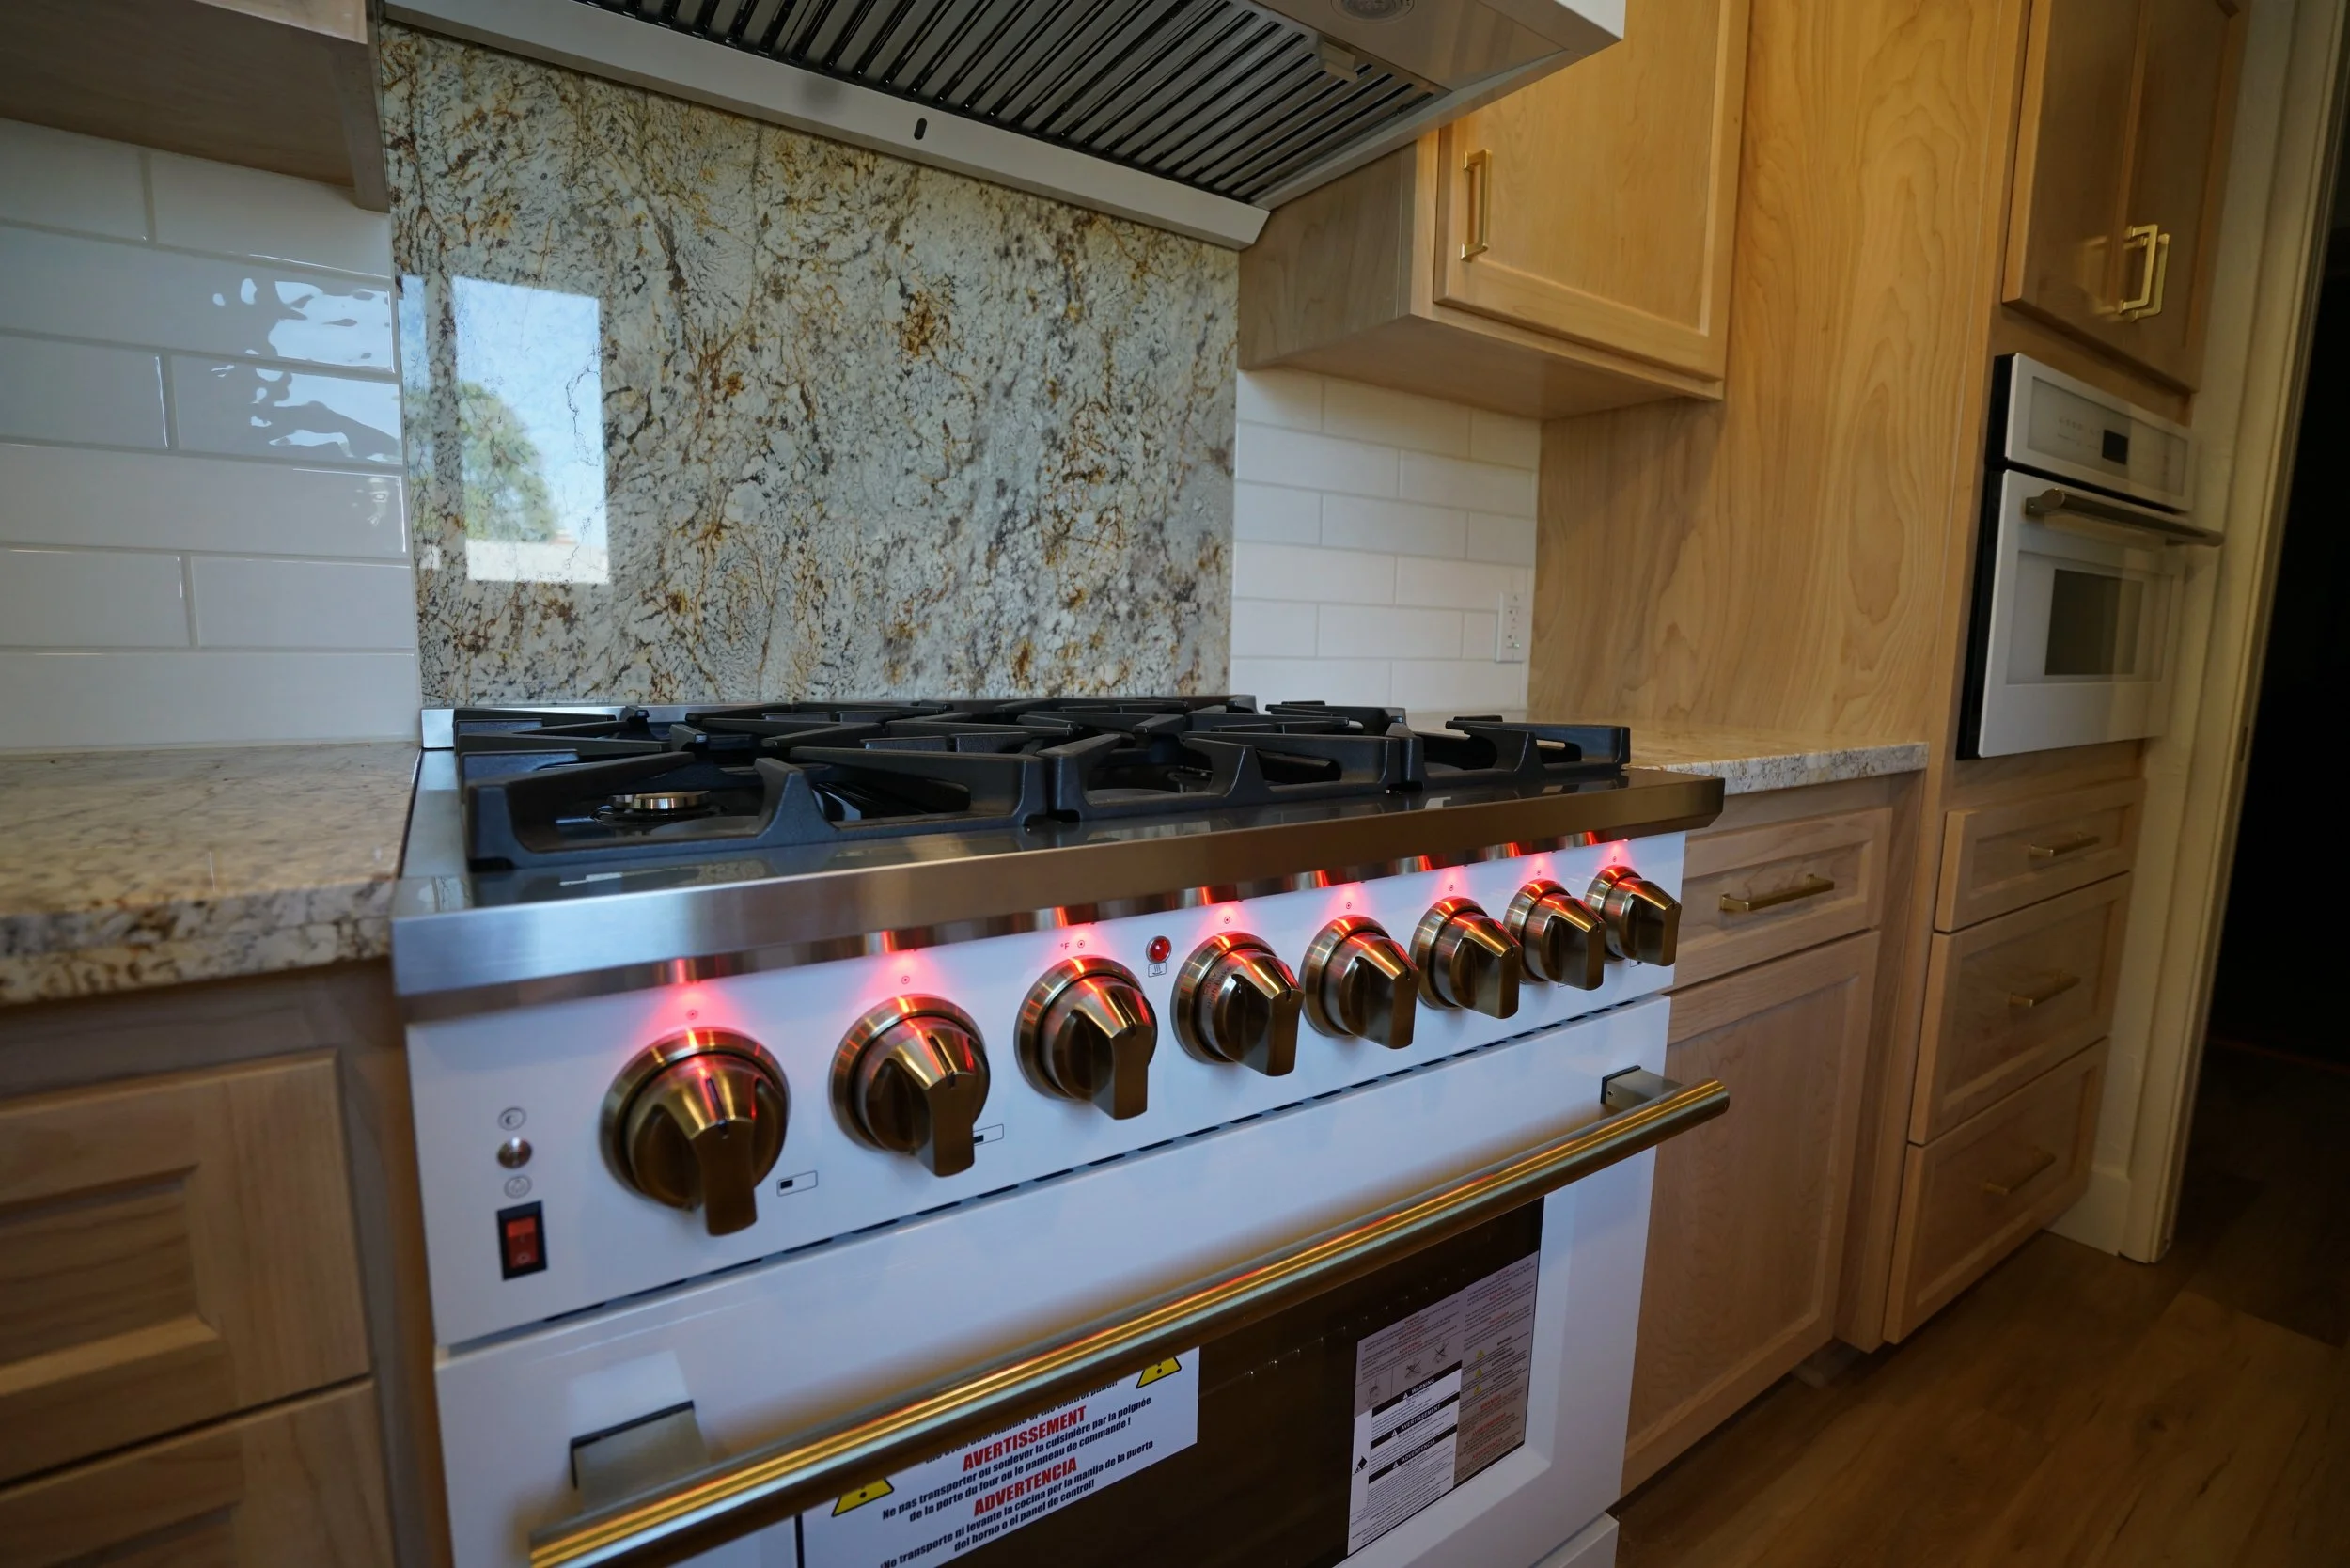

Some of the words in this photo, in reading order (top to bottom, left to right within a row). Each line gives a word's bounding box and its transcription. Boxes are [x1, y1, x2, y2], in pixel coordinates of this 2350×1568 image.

[1401, 1403, 1442, 1431] AVERTISSEMENT
[1411, 1378, 1435, 1394] WARNING
[883, 1508, 896, 1520] Ne
[899, 1498, 916, 1514] pas
[919, 1472, 977, 1504] transporter
[979, 1467, 991, 1479] ou
[993, 1448, 1034, 1473] soulever
[1036, 1444, 1044, 1454] la
[1045, 1426, 1090, 1450] cuisinière
[1092, 1416, 1106, 1431] par
[1108, 1411, 1117, 1421] la
[1118, 1396, 1152, 1419] poignée
[910, 1511, 922, 1522] de
[925, 1505, 934, 1515] la
[936, 1492, 963, 1512] porte
[965, 1486, 978, 1497] du
[979, 1477, 999, 1492] four
[1001, 1471, 1012, 1482] ou
[1014, 1463, 1024, 1473] le
[1026, 1449, 1065, 1473] panneau
[1066, 1441, 1077, 1453] de
[1079, 1420, 1126, 1448] commande
[963, 1405, 1087, 1472] AVERTISSEMENT
[1401, 1439, 1435, 1463] ADVERTENCIA
[899, 1535, 953, 1563] transporte
[955, 1527, 964, 1538] ni
[967, 1510, 1002, 1533] levante
[1005, 1504, 1013, 1514] la
[1015, 1493, 1046, 1512] cocina
[1047, 1485, 1062, 1497] por
[1064, 1478, 1073, 1488] la
[1073, 1463, 1104, 1483] manija
[1104, 1458, 1116, 1469] de
[1117, 1452, 1125, 1462] la
[1126, 1440, 1153, 1459] puerta
[954, 1538, 970, 1552] del
[972, 1525, 1000, 1544] horno
[1002, 1521, 1008, 1529] o
[1010, 1514, 1019, 1526] el
[1020, 1505, 1046, 1522] panel
[1047, 1497, 1059, 1509] de
[1060, 1479, 1095, 1501] control!
[974, 1457, 1077, 1517] ADVERTENCIA
